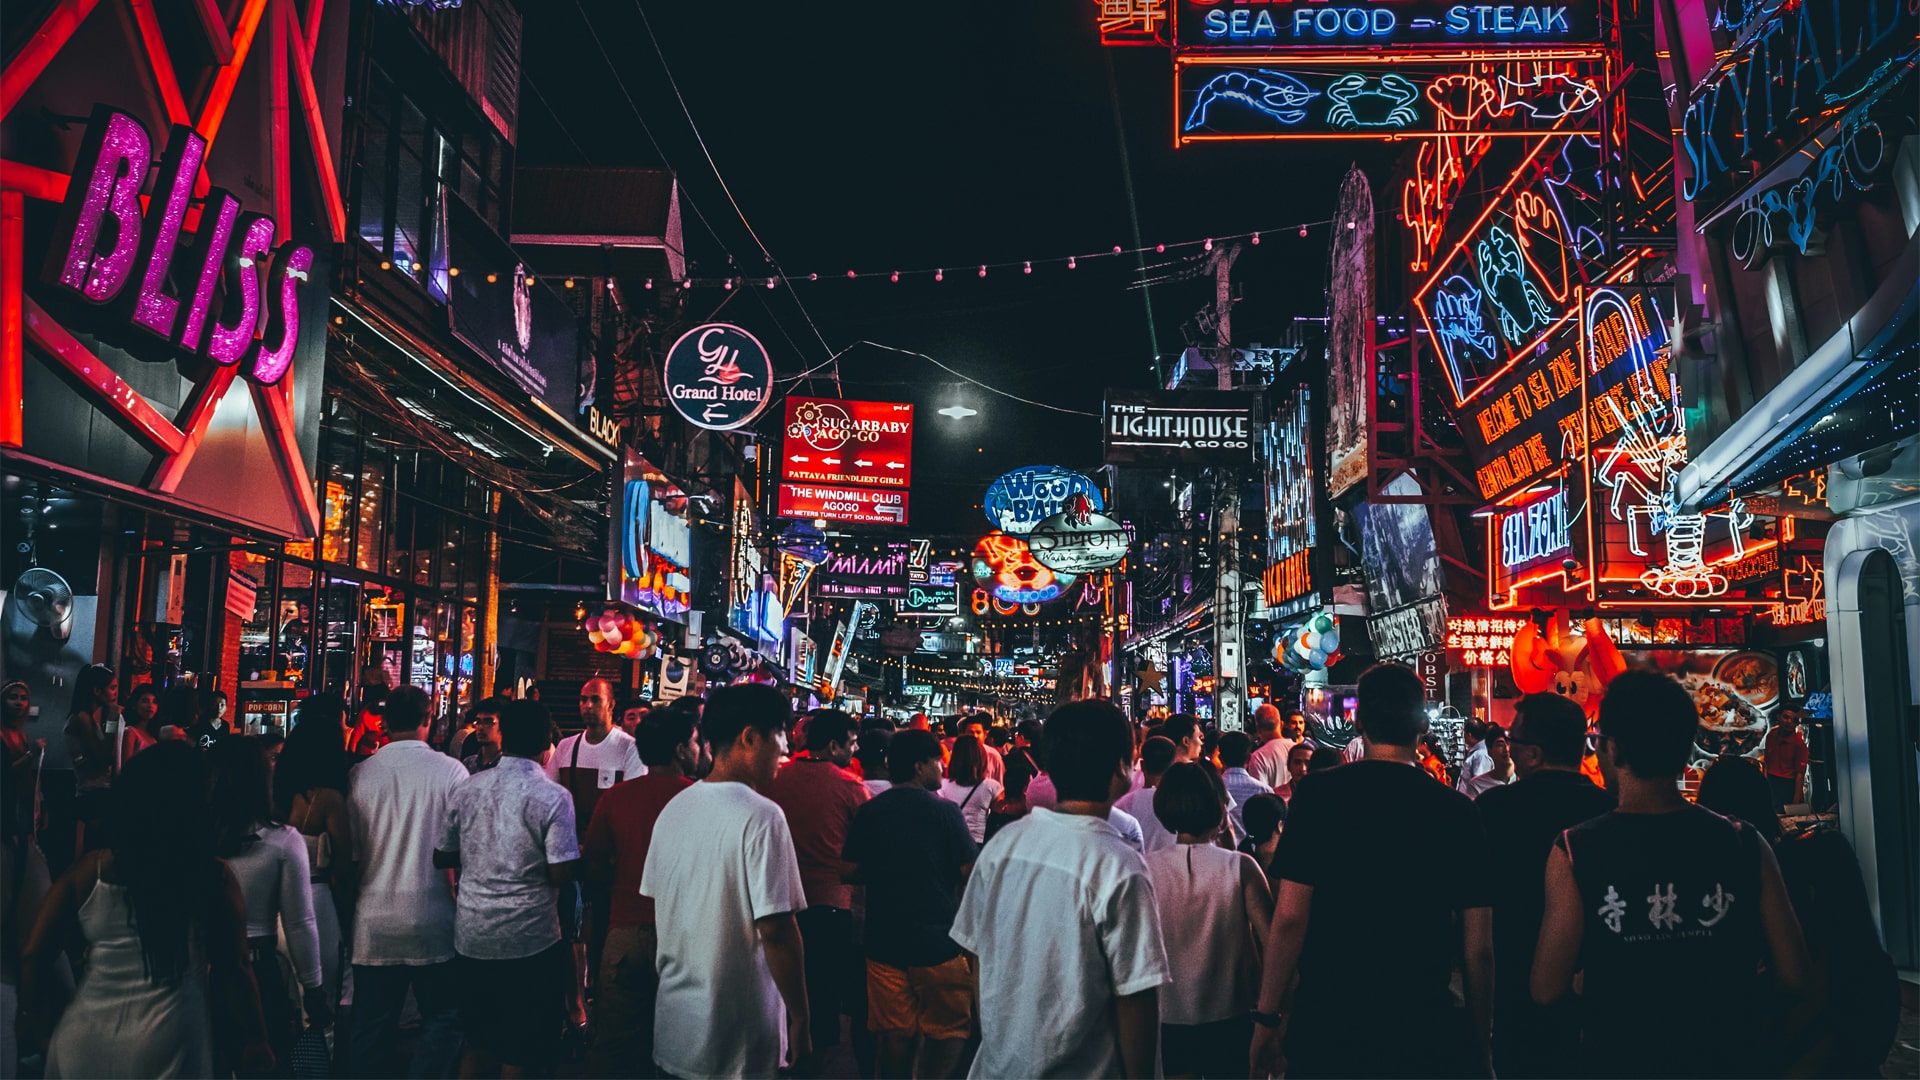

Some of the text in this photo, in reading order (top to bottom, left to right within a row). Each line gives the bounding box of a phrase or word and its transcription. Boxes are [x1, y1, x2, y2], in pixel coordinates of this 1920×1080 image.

[1204, 8, 1276, 37] SEA
[1293, 8, 1396, 37] FOOD
[1446, 6, 1568, 34] STEAK
[60, 111, 314, 386] BLISS
[672, 384, 762, 402] Grand Hotel
[1476, 391, 1521, 445] WELCOME
[1511, 384, 1533, 420] TO
[1527, 371, 1555, 410] SEA
[1554, 348, 1582, 399] ZONE
[1110, 405, 1145, 413] THE
[821, 417, 910, 434] SUGARBABY
[1111, 414, 1247, 438] LIGHTHOUSE
[818, 428, 880, 442] AGO-GO
[1179, 440, 1248, 449] A GO GO
[788, 471, 904, 485] PATTAYA FRIENDLIEST GIRLS
[790, 487, 902, 504] THE WINDMILL CLUB
[822, 501, 859, 512] AGOGO
[1038, 526, 1125, 550] SIMON
[1503, 511, 1529, 567] SEA
[248, 703, 284, 711] POPCORN
